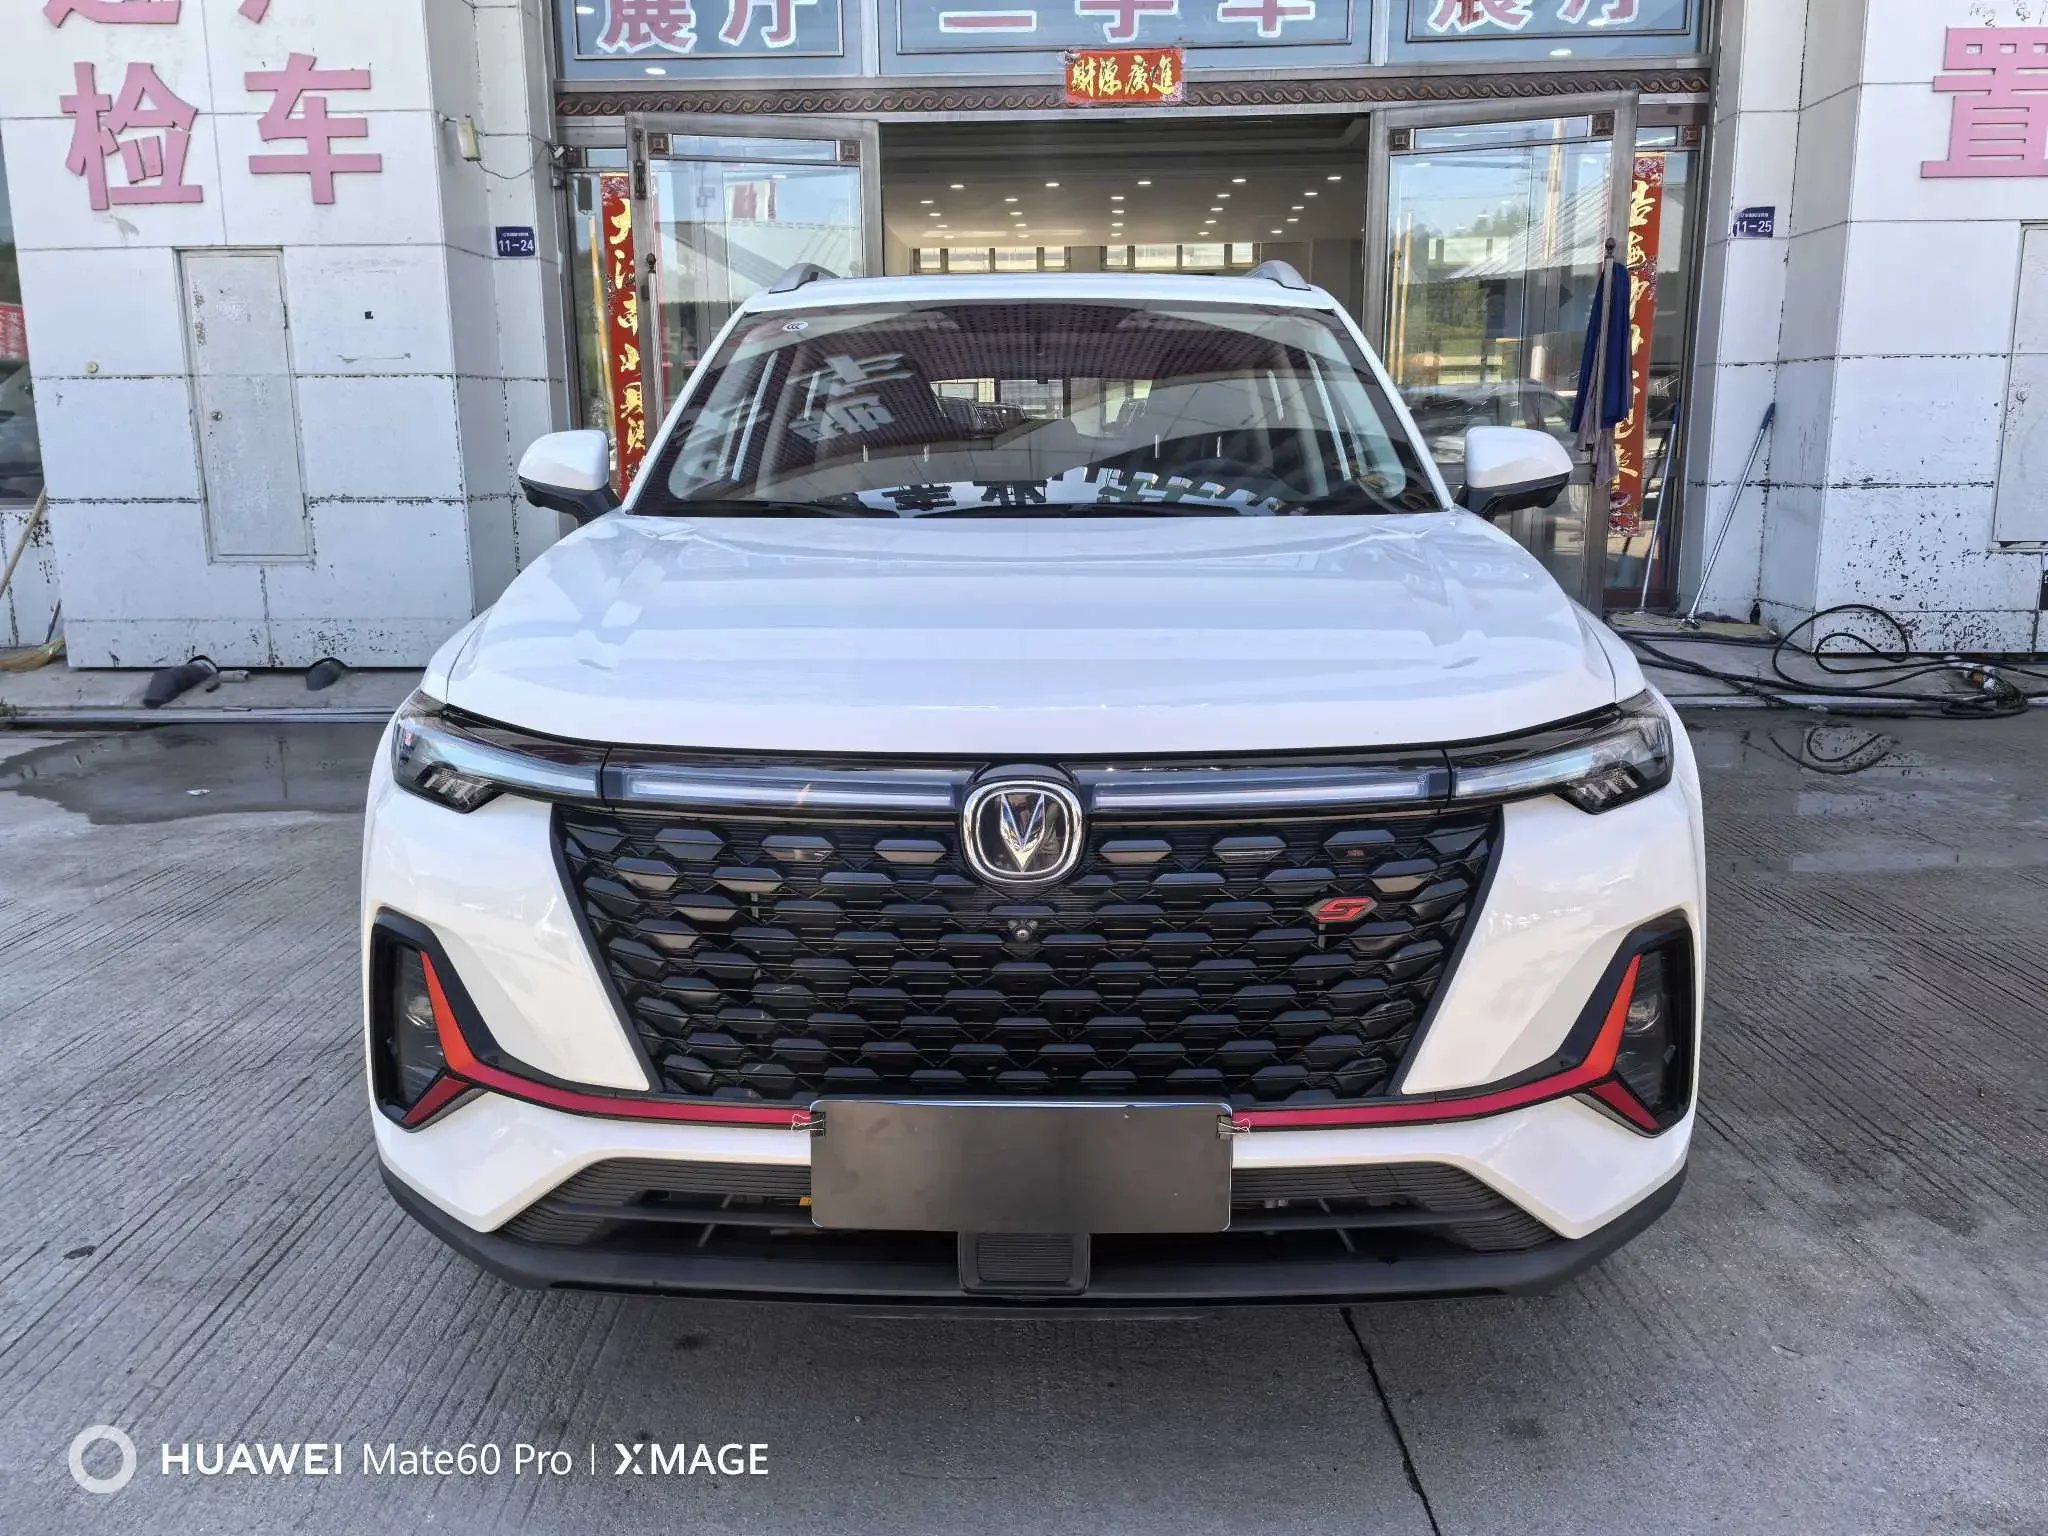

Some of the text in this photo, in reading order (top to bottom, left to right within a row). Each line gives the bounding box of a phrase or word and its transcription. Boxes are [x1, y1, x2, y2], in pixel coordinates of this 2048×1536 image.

[60, 52, 382, 211] 检车
[1735, 220, 1773, 233] 11-25
[498, 239, 535, 252] 11-24
